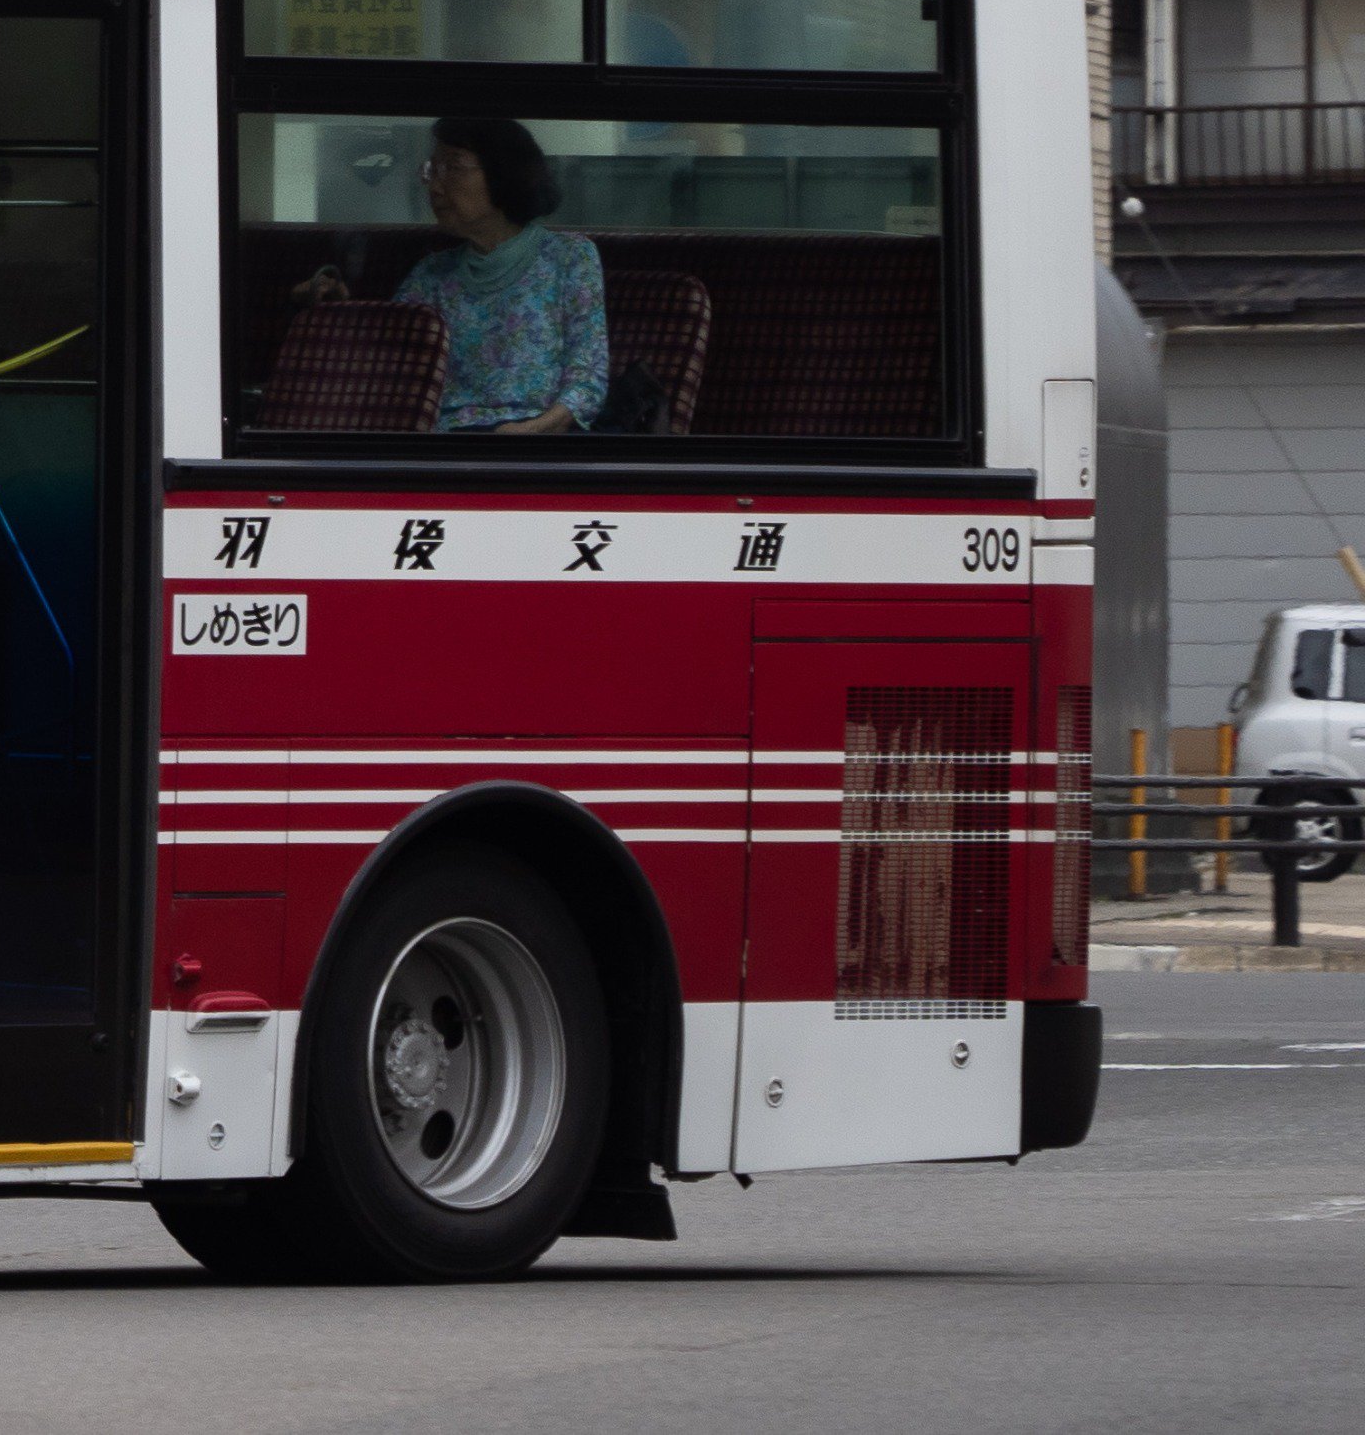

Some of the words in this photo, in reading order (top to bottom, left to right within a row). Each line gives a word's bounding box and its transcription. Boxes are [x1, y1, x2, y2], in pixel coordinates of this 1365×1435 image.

[962, 527, 1020, 573] 309
[178, 598, 303, 650] しめきり
